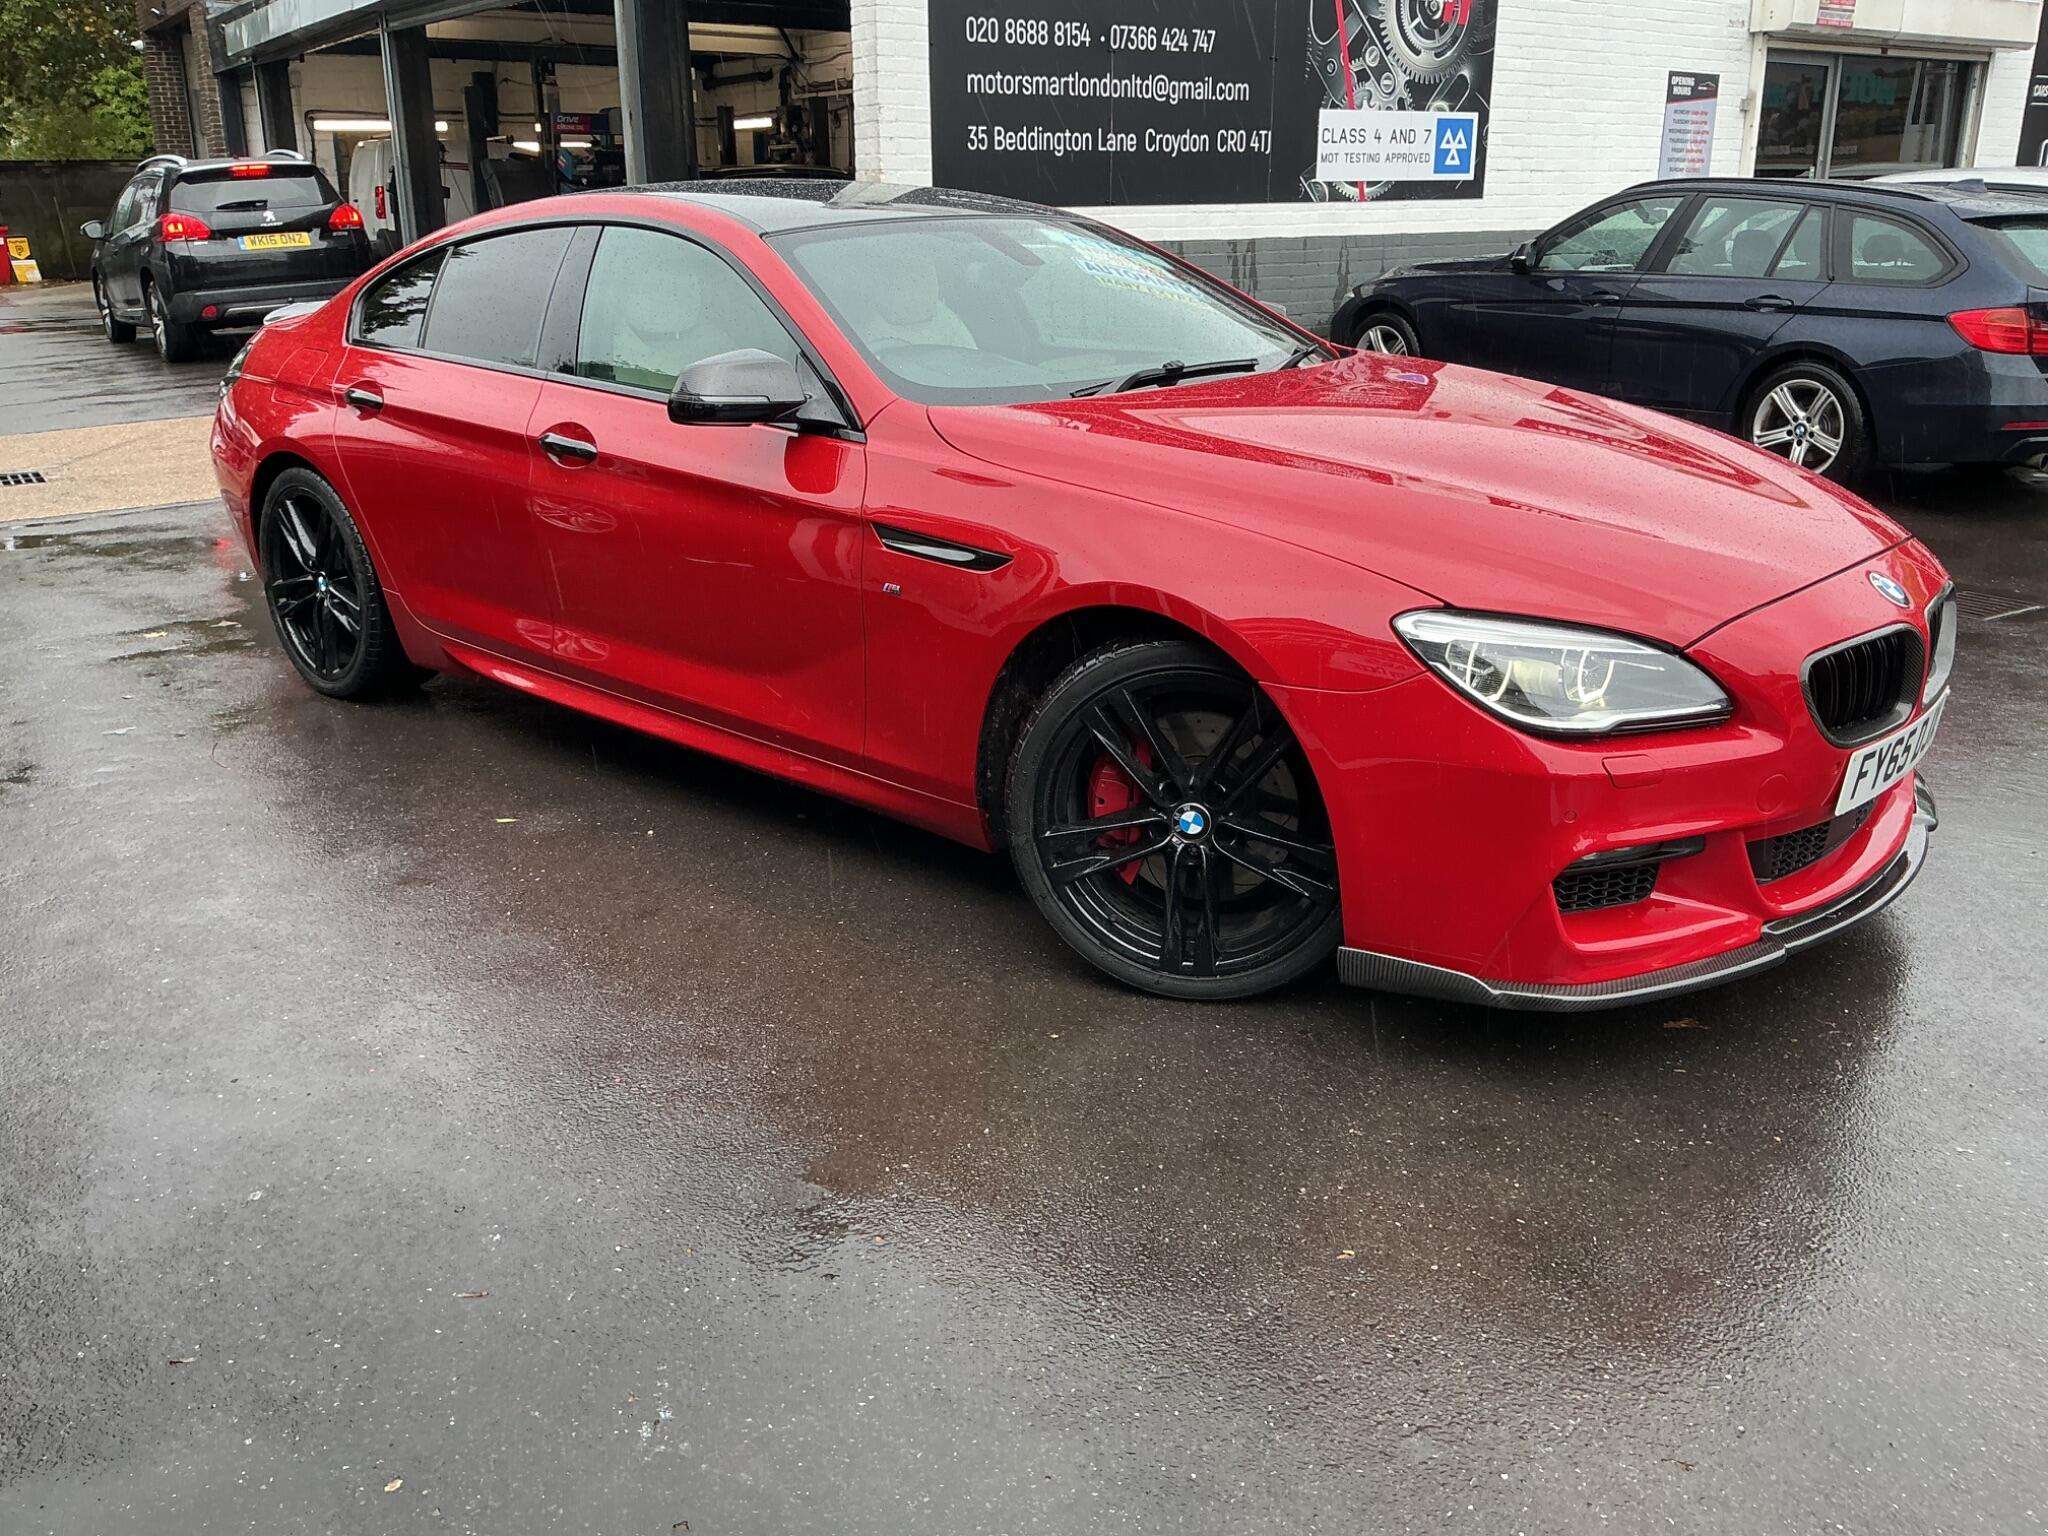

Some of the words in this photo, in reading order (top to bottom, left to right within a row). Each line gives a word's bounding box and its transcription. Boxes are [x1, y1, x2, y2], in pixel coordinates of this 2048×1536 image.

[966, 16, 999, 43] 020
[1005, 18, 1049, 46] 8688
[1054, 21, 1091, 47] 8154
[1109, 24, 1157, 51] 07366
[1161, 27, 1188, 52] 424
[1192, 29, 1216, 53] 747
[966, 71, 1250, 104] motorsmartlondonltd@gmail.com
[1671, 76, 1695, 86] OPENING
[1672, 86, 1692, 96] HOURS
[967, 125, 989, 151] 35
[994, 126, 1092, 157] Beddington
[1098, 128, 1137, 152] Lane
[1145, 128, 1209, 158] Croydon
[1250, 130, 1272, 155] 4TJ
[1321, 128, 1367, 144] CLASS
[1373, 128, 1382, 144] 4
[1390, 128, 1416, 144] AND
[1424, 129, 1432, 144] 7
[1321, 152, 1340, 163] MOT
[1344, 152, 1380, 163] TESTING
[1384, 153, 1430, 164] APPROVED
[1850, 727, 1918, 800] FY65
